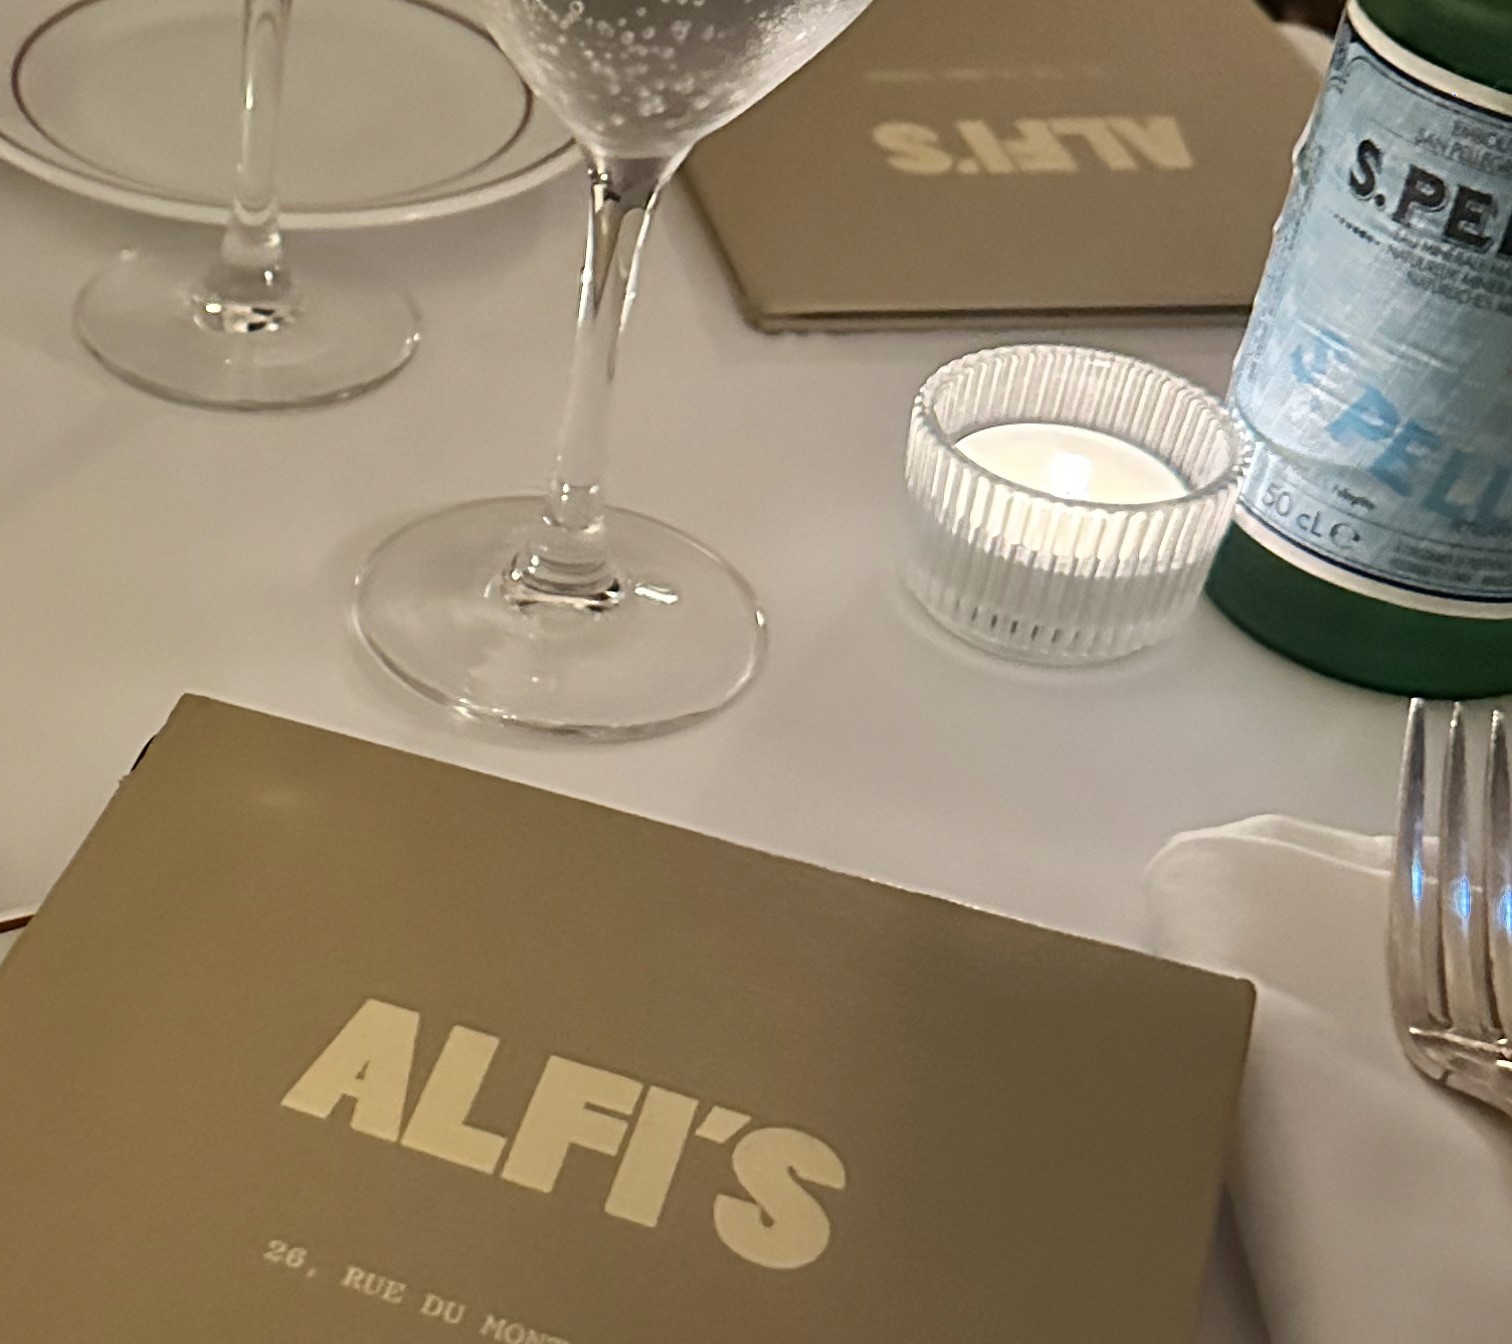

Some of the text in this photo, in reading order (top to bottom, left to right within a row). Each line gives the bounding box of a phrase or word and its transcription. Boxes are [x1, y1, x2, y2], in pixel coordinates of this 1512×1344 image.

[872, 115, 1195, 175] ALFI'S
[1349, 138, 1512, 255] S.PE
[1261, 484, 1292, 517] 50
[280, 998, 847, 1270] ALFI'S
[263, 1239, 319, 1278] 26,
[341, 1265, 407, 1303] RUE
[420, 1293, 467, 1325] DU
